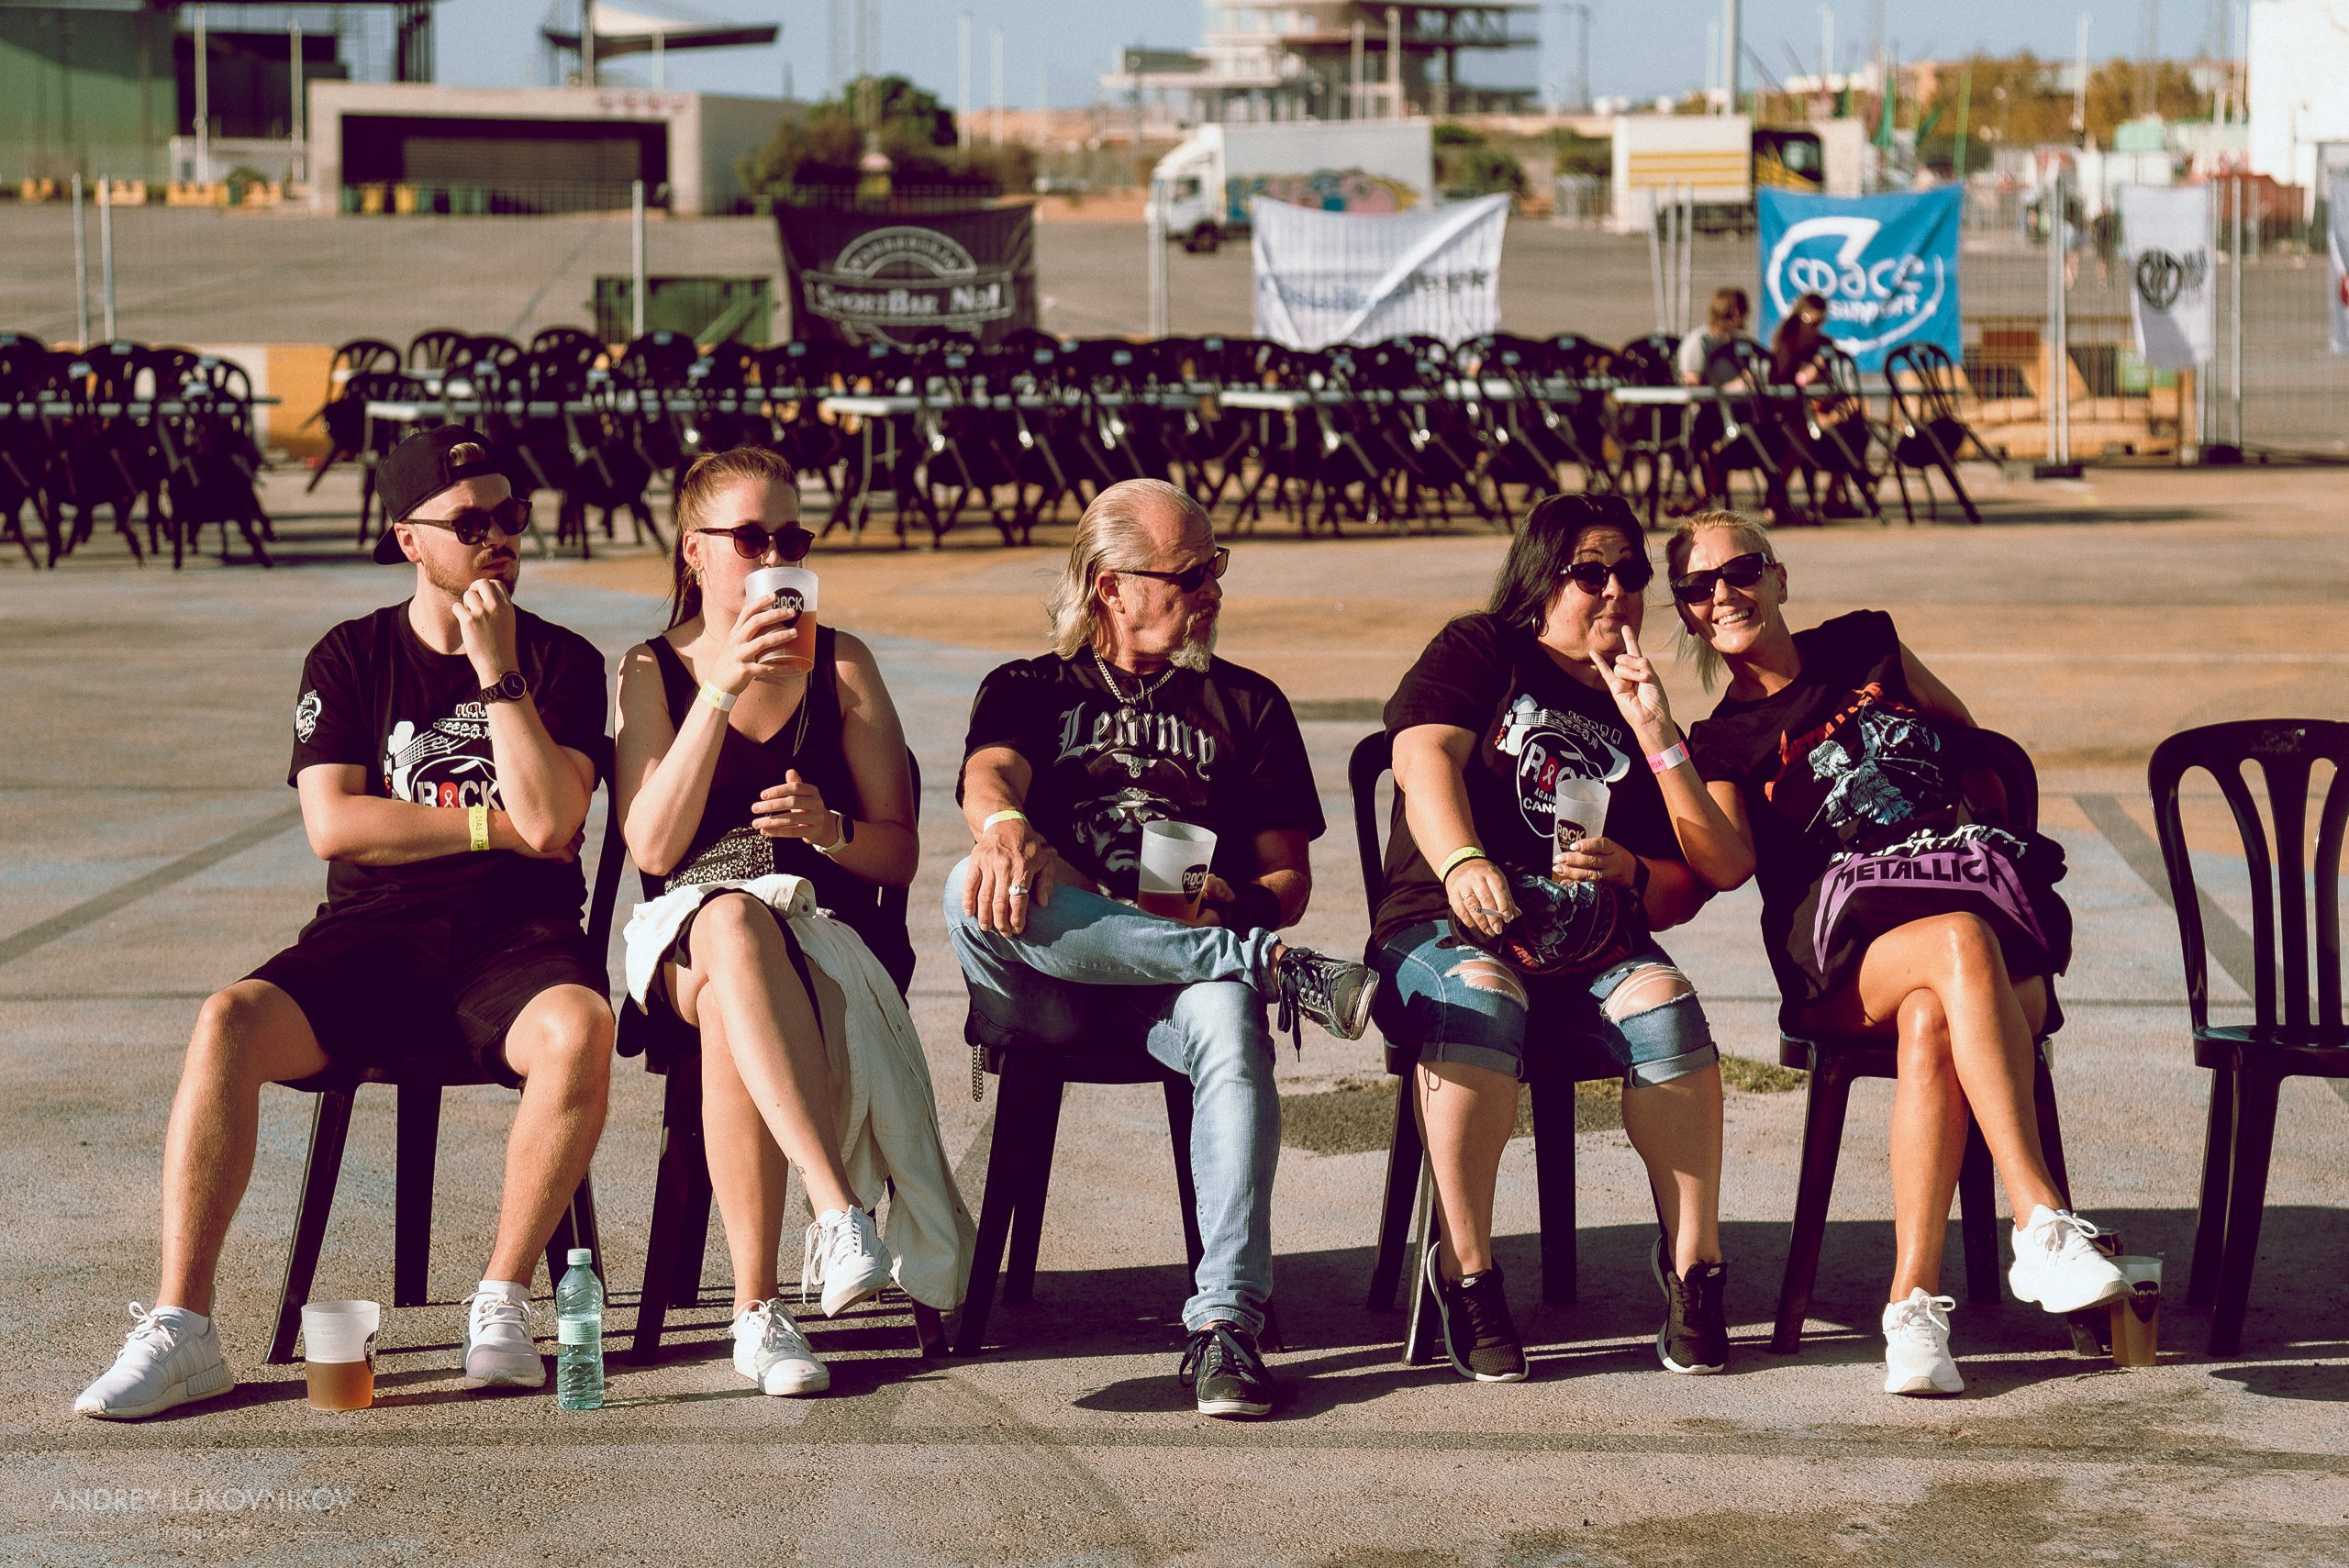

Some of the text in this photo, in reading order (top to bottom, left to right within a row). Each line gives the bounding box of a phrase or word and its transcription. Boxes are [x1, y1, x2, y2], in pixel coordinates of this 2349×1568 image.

[1053, 701, 1218, 781] Lemmy
[417, 779, 507, 812] ROCK
[1522, 796, 1557, 814] CAN
[1533, 786, 1557, 804] AGAIN
[1557, 822, 1586, 843] ROCK
[1814, 837, 2051, 974] METALLICA
